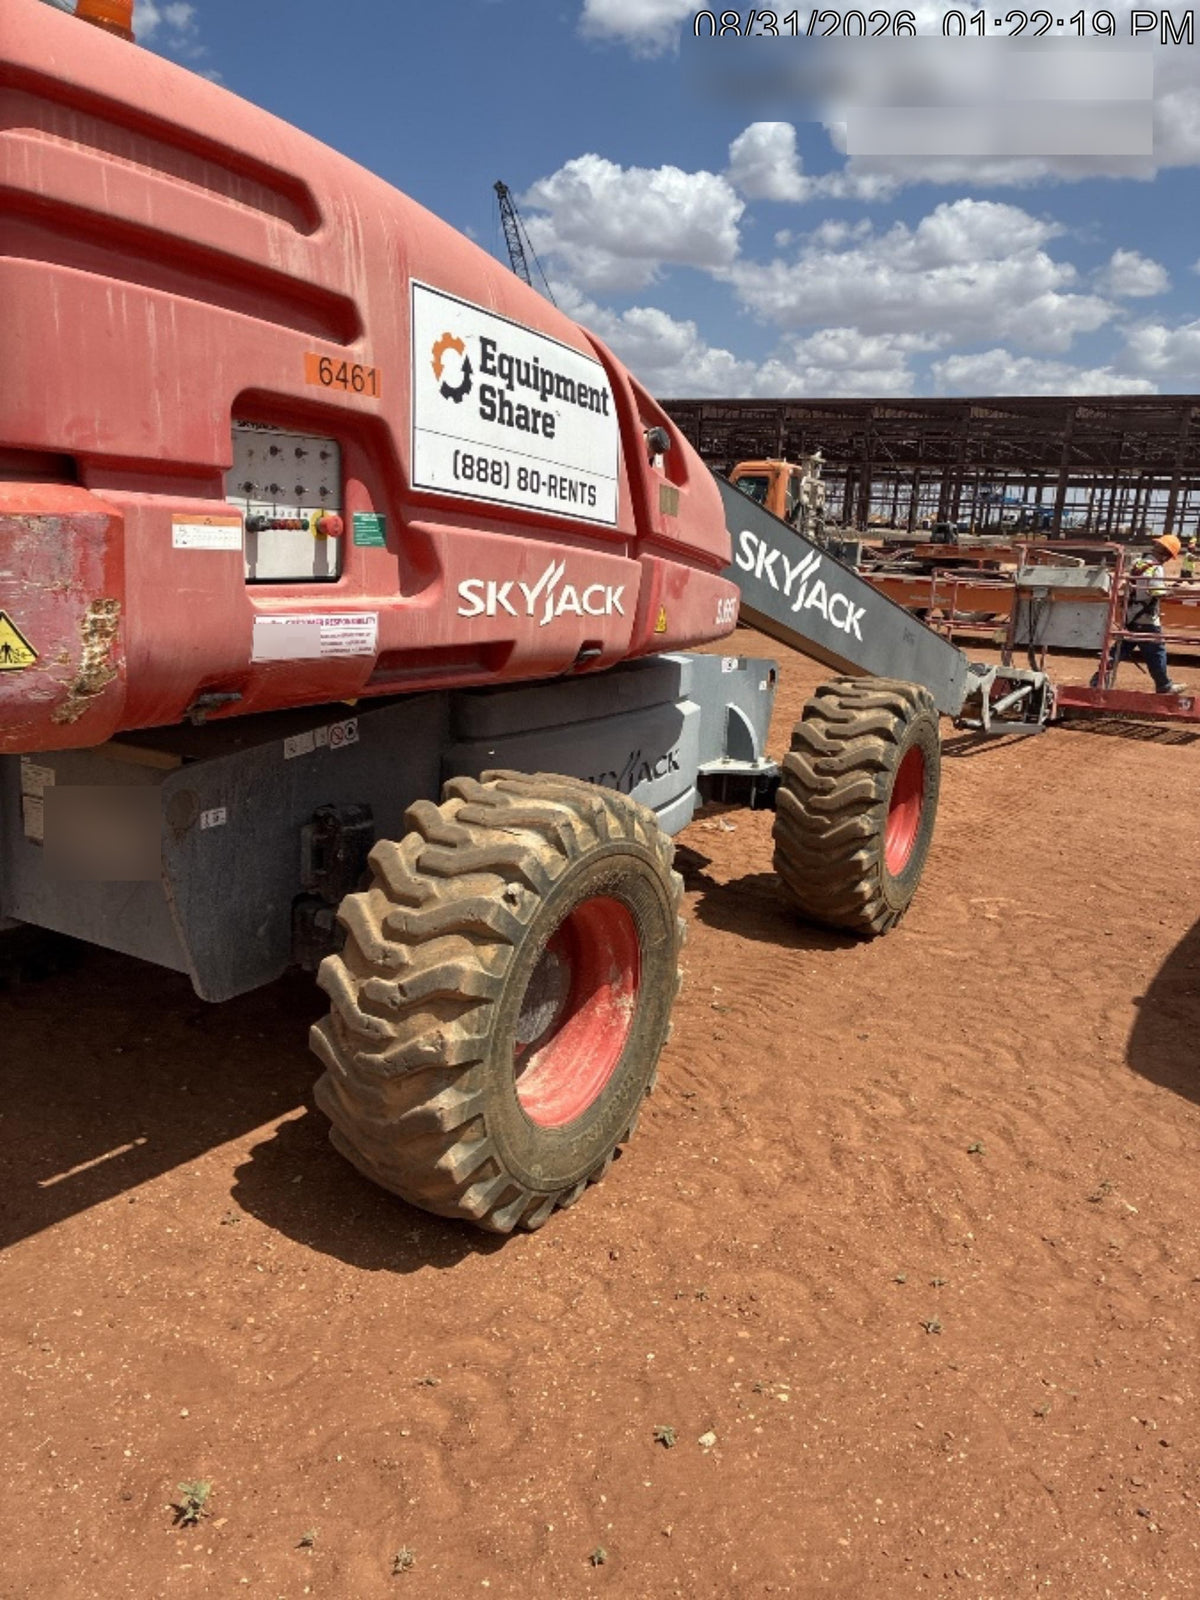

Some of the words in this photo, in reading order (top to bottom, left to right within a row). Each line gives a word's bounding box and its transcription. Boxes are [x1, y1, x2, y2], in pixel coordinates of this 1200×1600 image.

[319, 356, 376, 396] 6461
[479, 335, 609, 417] Equipment
[479, 383, 556, 439] Share
[452, 449, 510, 490] (888)
[517, 466, 597, 507] 80-RENTS
[457, 559, 625, 627] SKYJACK
[735, 530, 867, 643] SKYJACK
